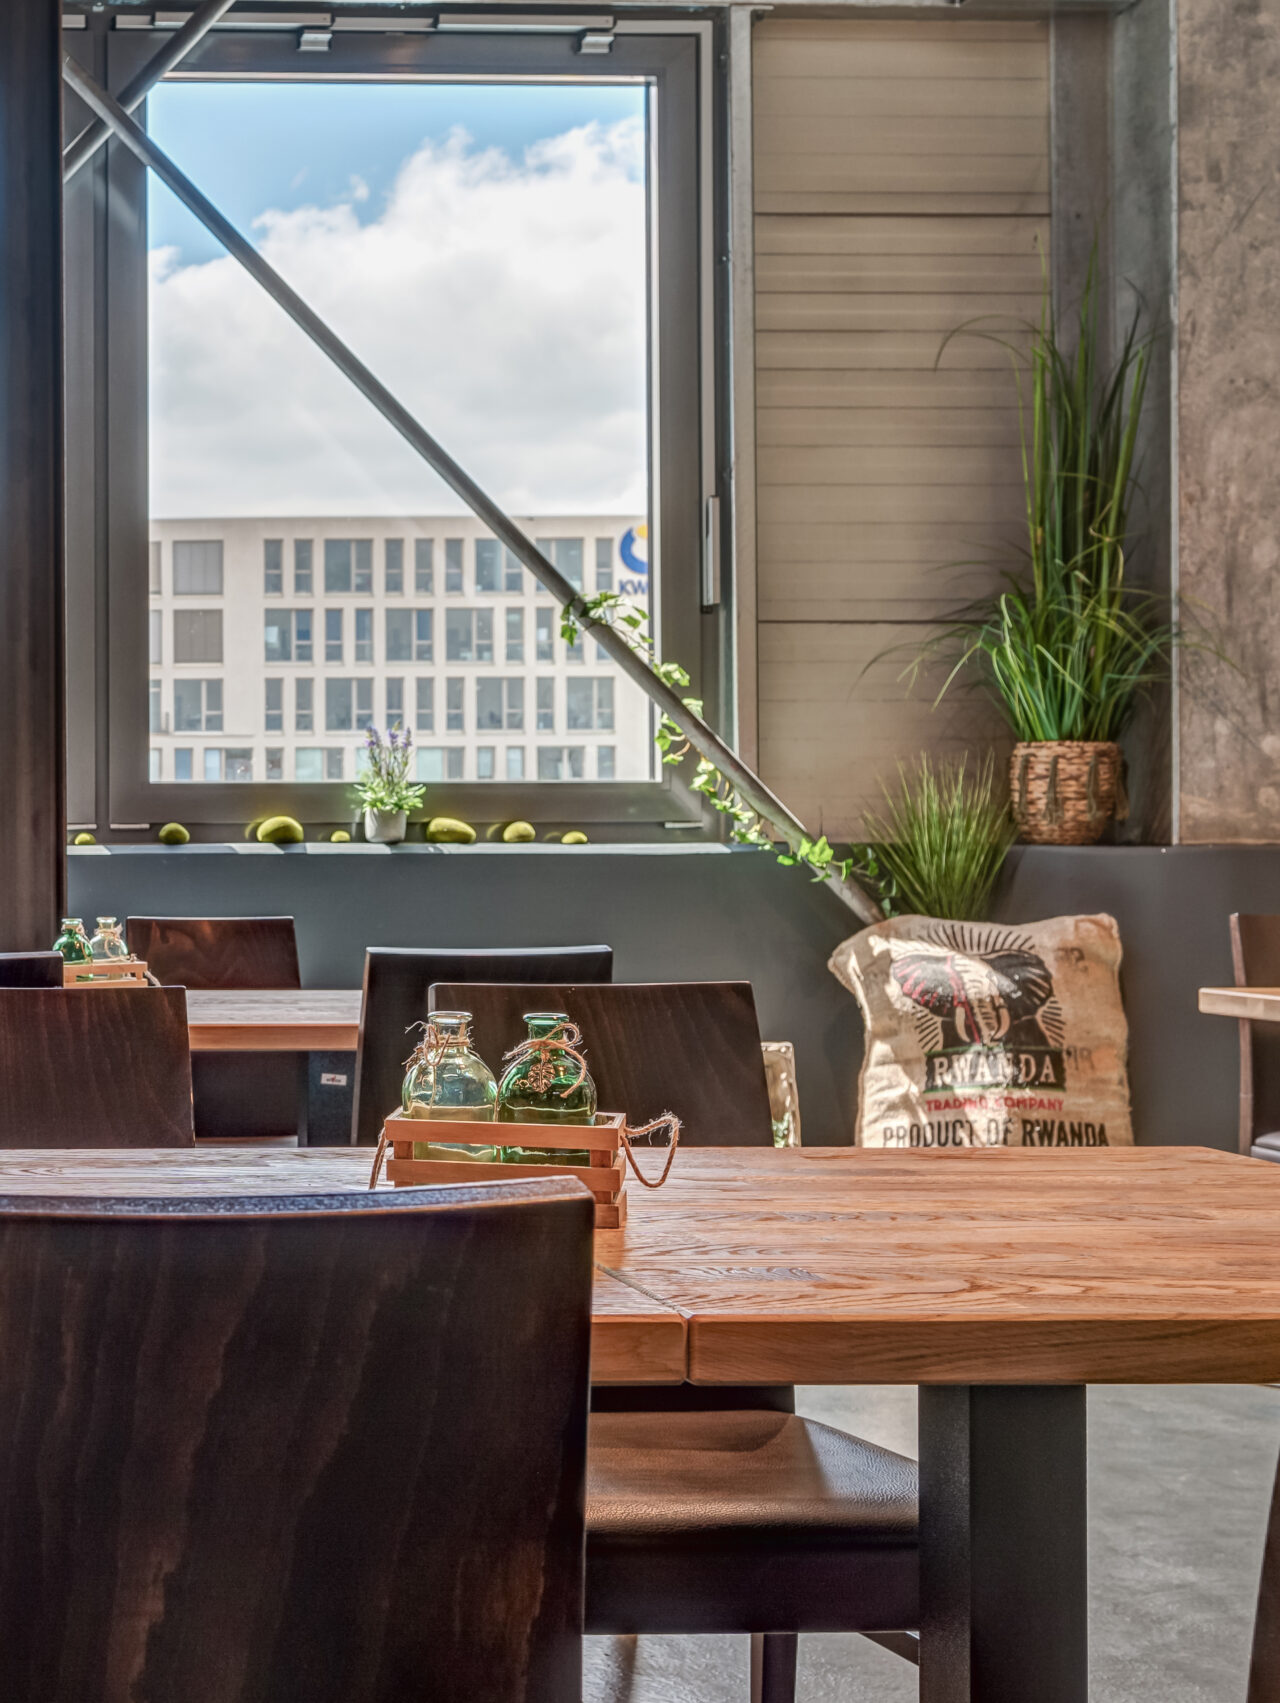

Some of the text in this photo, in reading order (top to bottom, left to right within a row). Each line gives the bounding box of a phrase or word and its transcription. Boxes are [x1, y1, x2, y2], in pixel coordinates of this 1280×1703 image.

[933, 1053, 1057, 1086] RWANDA
[925, 1096, 989, 1112] TRADING
[883, 1117, 1110, 1148] PRODUCT OF RWANDA
